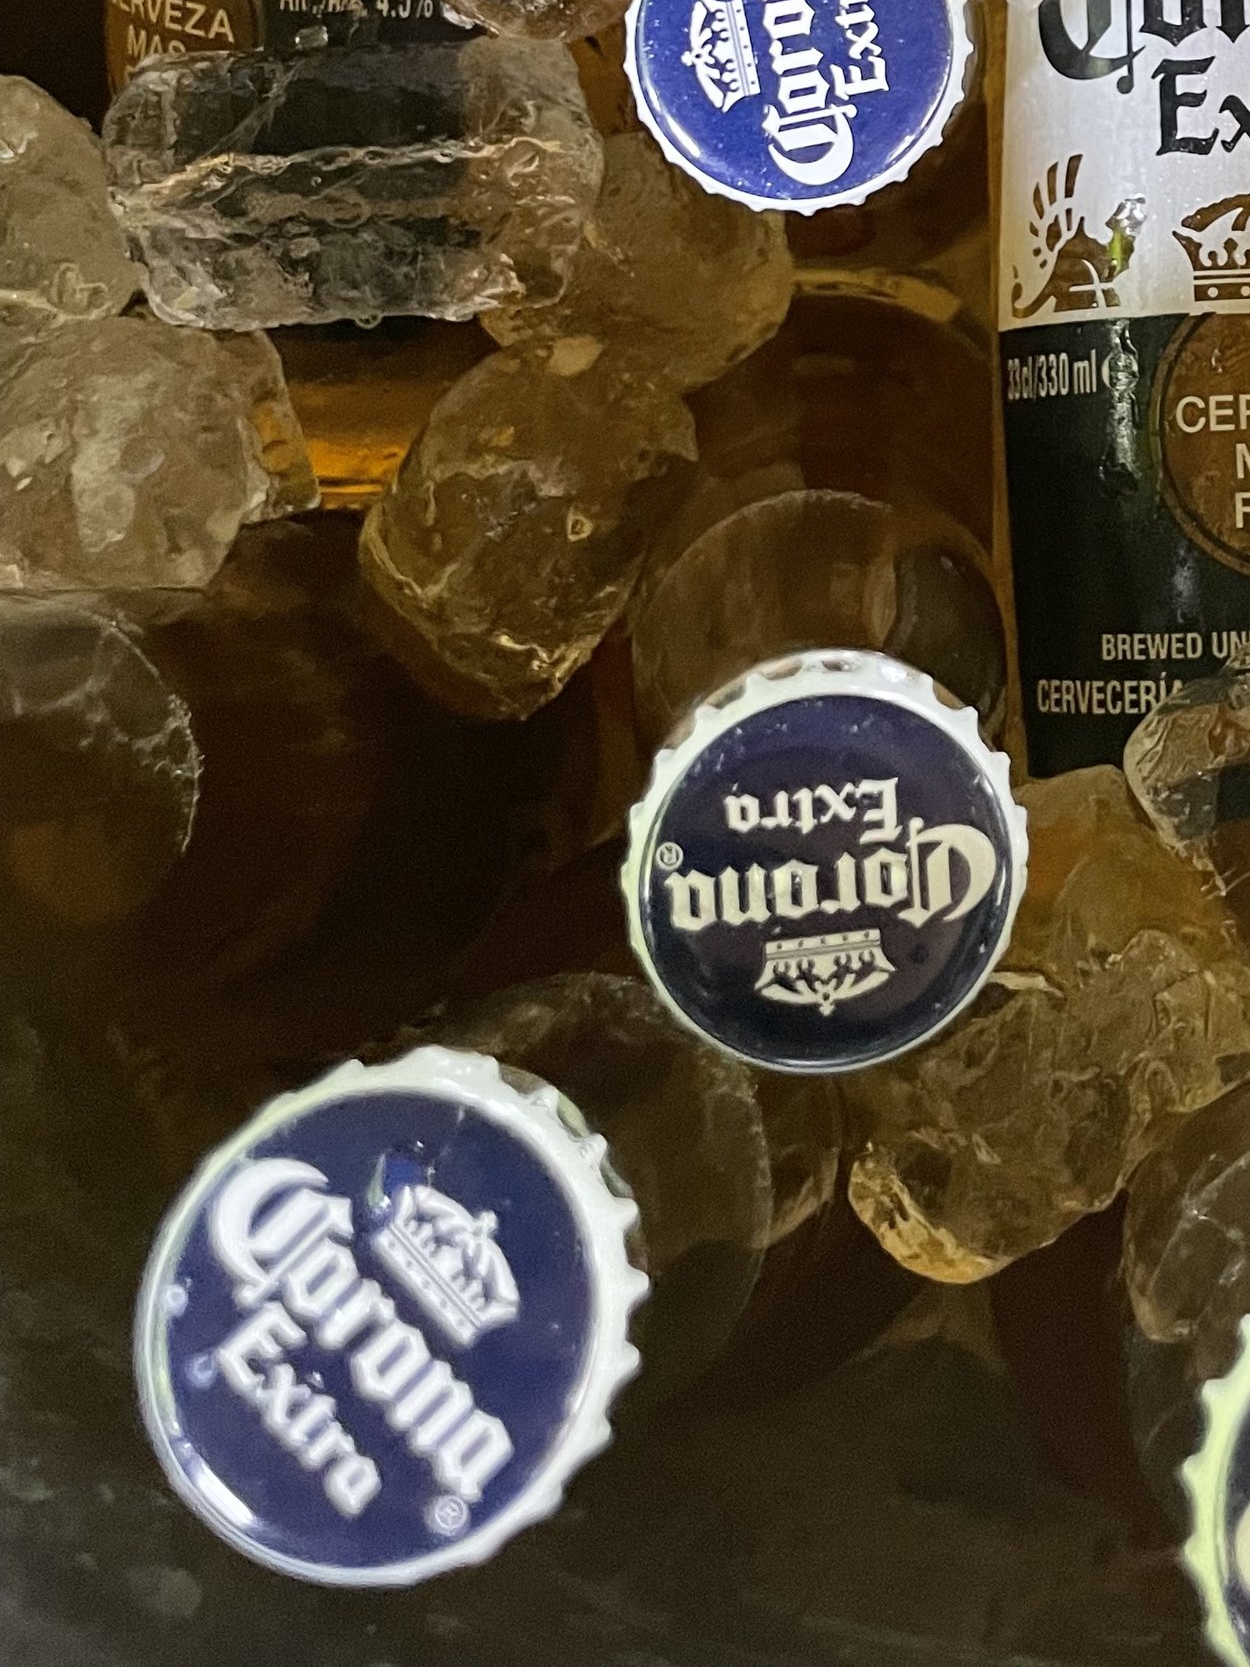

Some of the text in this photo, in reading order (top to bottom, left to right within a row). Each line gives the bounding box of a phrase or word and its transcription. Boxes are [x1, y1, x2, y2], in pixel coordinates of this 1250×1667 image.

[1073, 348, 1098, 394] ml
[1102, 631, 1201, 661] BREWED
[723, 777, 902, 844] Extra
[216, 1300, 382, 1518] Extra
